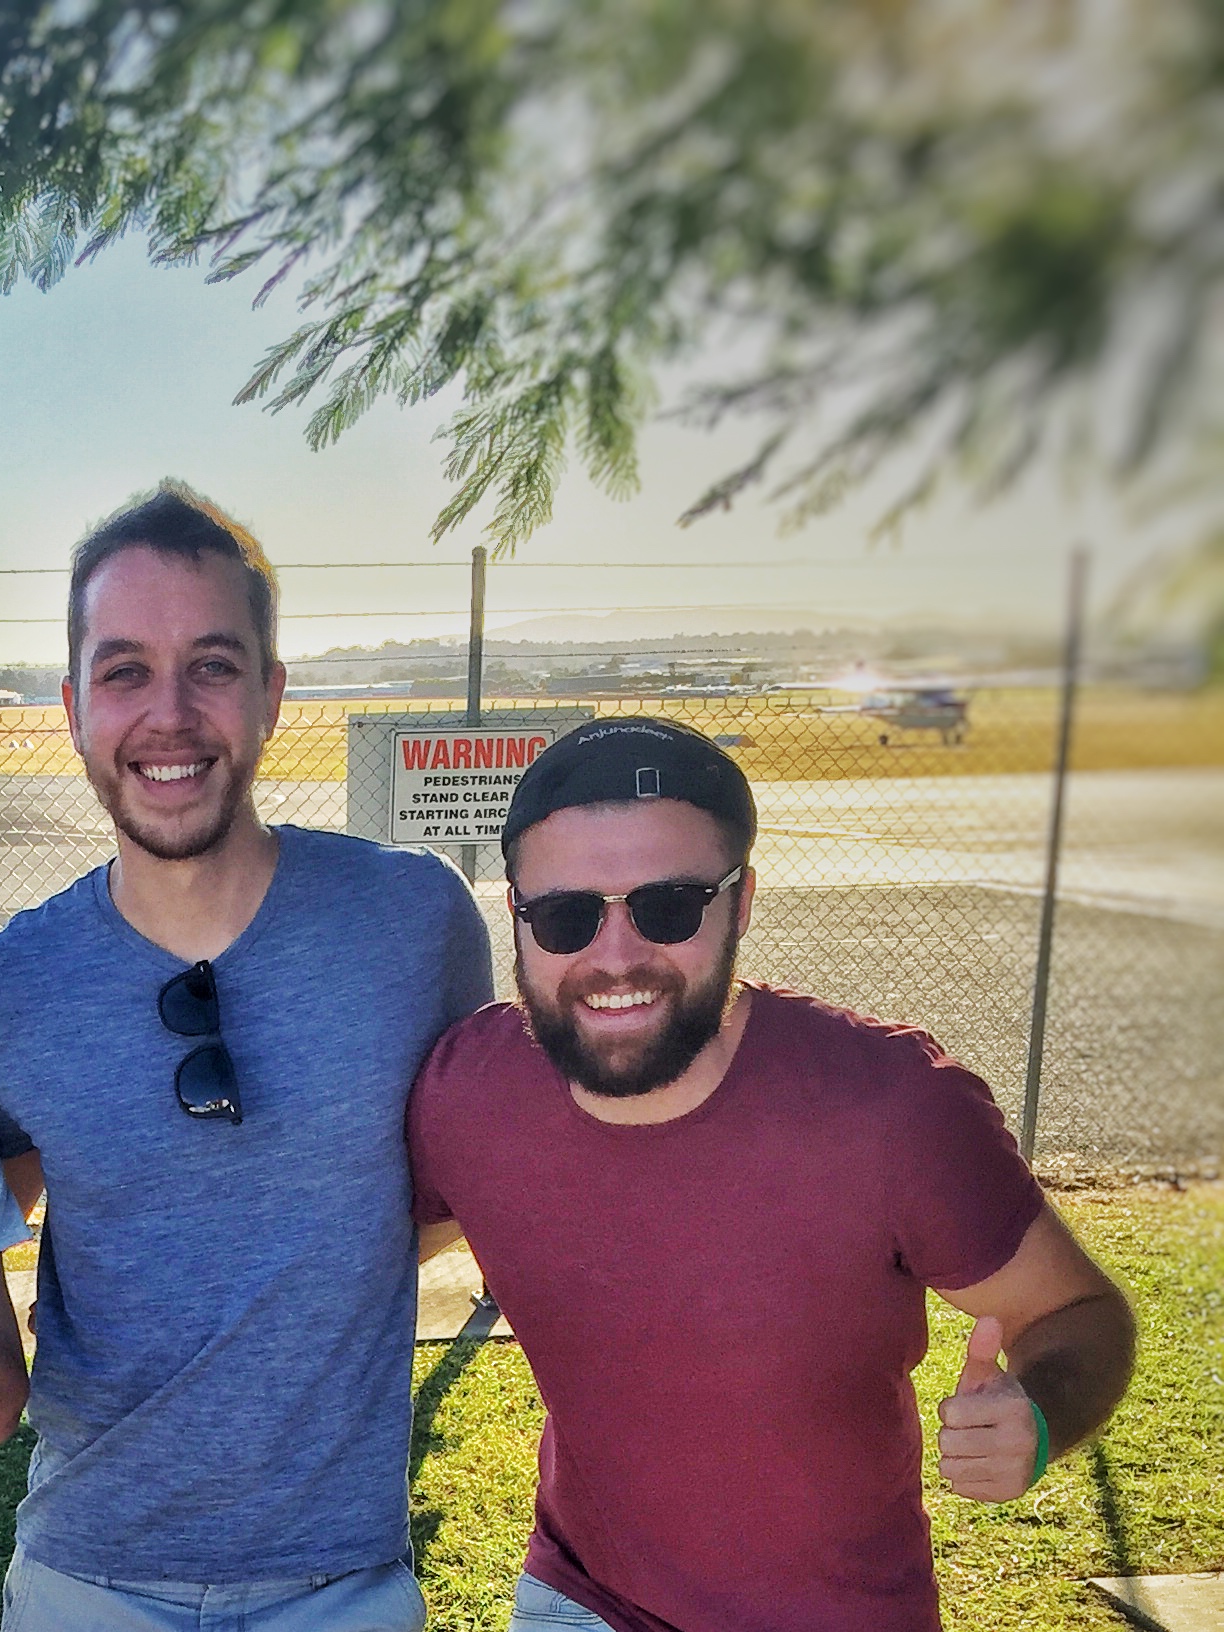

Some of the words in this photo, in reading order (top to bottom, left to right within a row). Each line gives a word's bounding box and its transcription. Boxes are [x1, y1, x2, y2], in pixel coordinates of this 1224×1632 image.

[402, 736, 547, 770] WARNING
[423, 774, 521, 787] PEDESTRIANS
[412, 792, 459, 804] STAND
[463, 791, 509, 803] CLEAR
[399, 809, 469, 820] STARTING
[423, 826, 440, 837] AT
[444, 825, 471, 836] ALL
